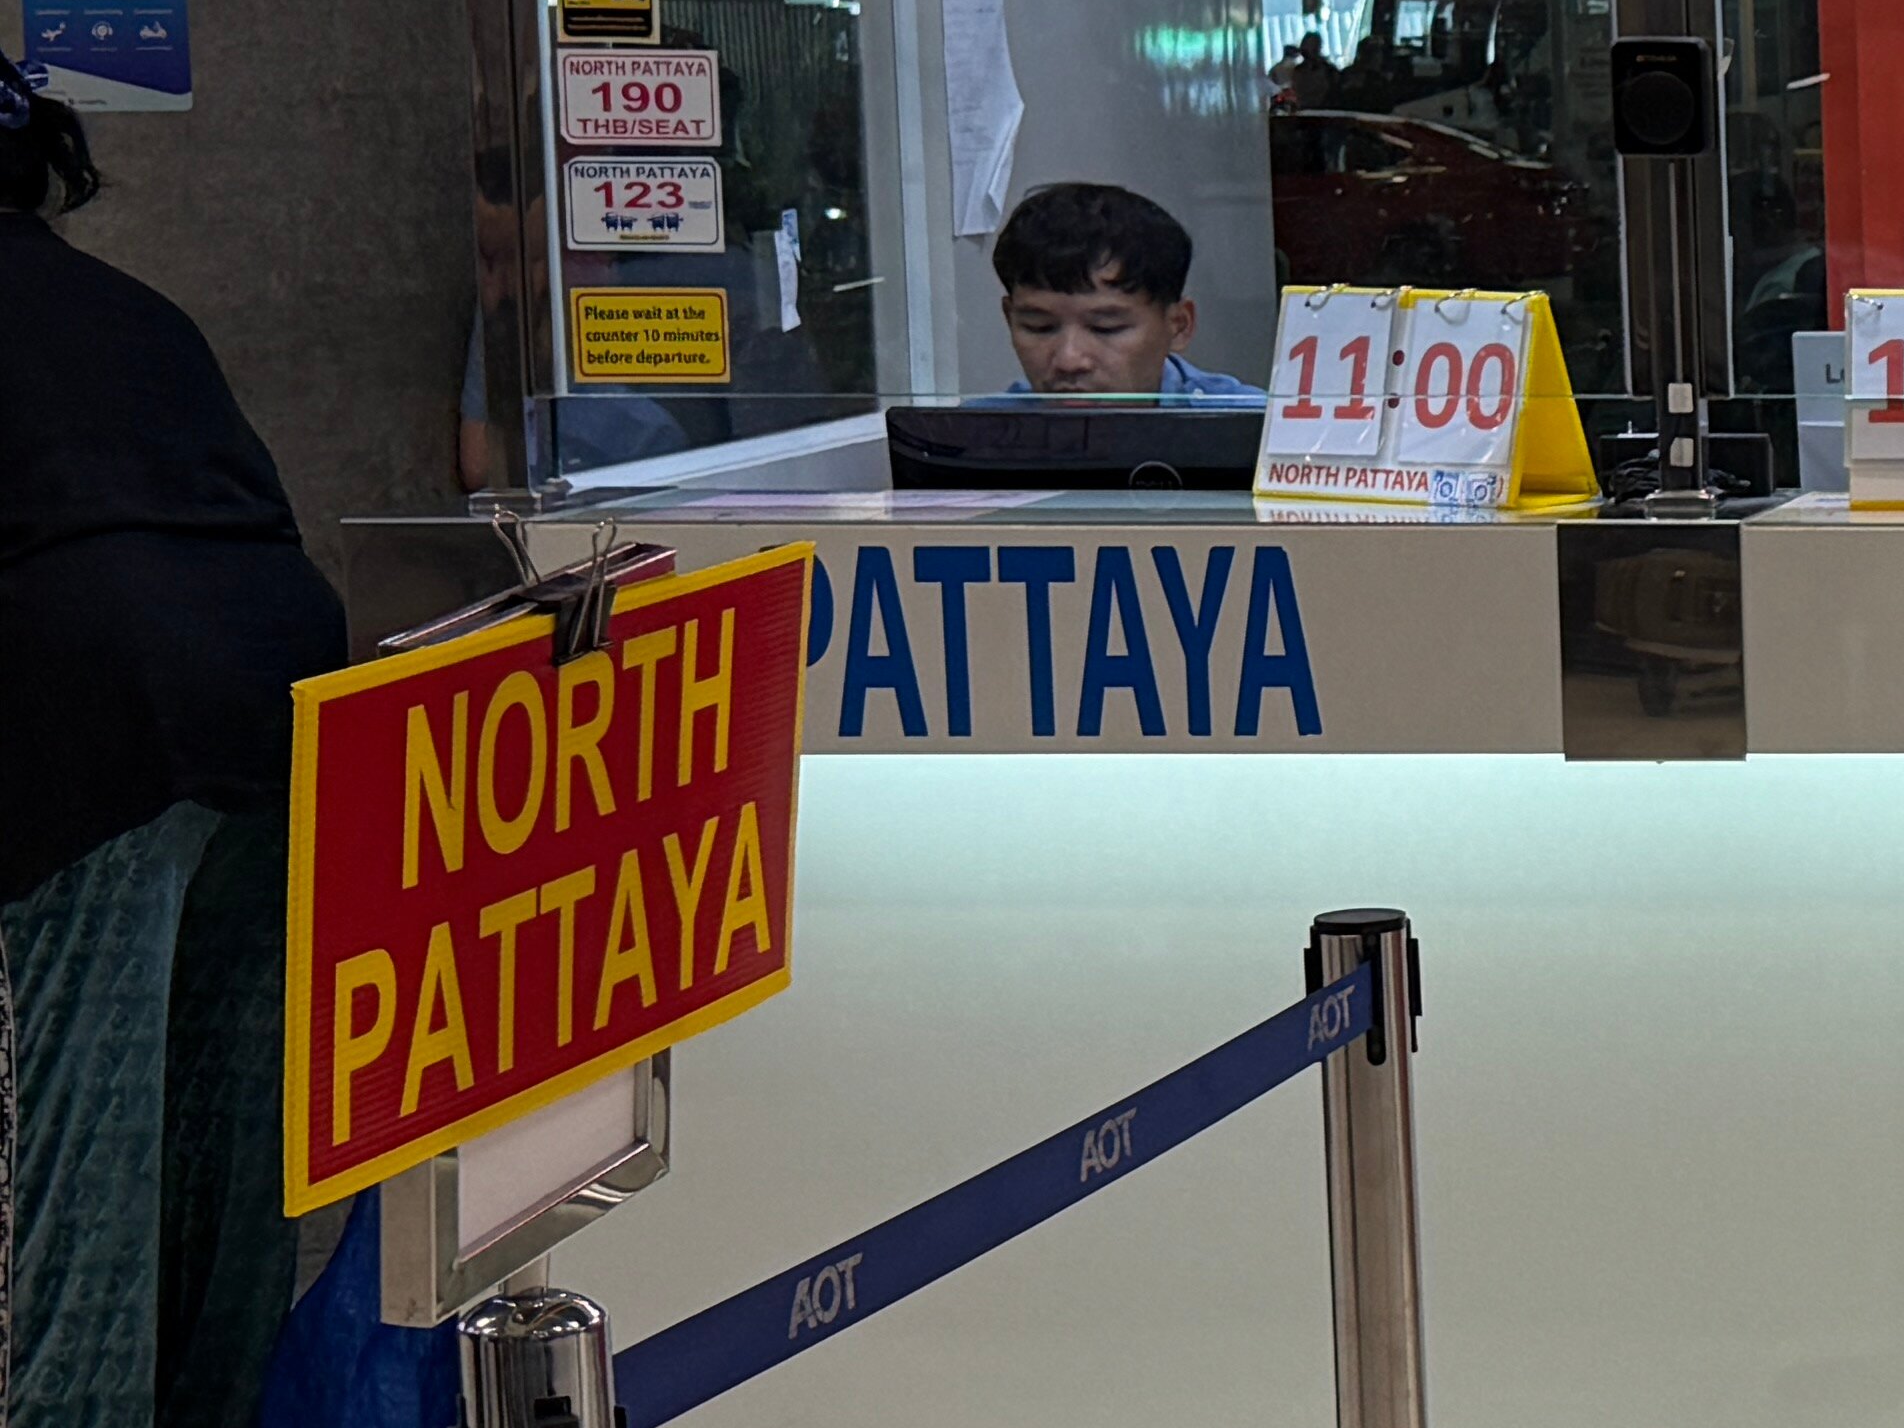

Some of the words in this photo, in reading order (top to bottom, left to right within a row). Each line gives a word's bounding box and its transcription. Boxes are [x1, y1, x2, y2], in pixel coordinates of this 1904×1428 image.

[569, 60, 625, 76] NORTH
[632, 60, 707, 77] PATTAYA
[591, 81, 682, 114] 190
[577, 118, 706, 136] THB/SEAT
[574, 165, 630, 179] NORTH
[636, 166, 712, 180] PATTAYA
[593, 181, 684, 209] 123
[584, 306, 629, 321] Please
[632, 306, 662, 321] wait
[666, 307, 680, 321] at
[683, 306, 705, 321] the
[586, 330, 639, 343] counter
[643, 329, 660, 343] 10
[663, 329, 720, 343] minutes
[587, 351, 633, 365] before
[636, 351, 710, 368] departure.
[1282, 335, 1516, 430] 11:00
[1268, 463, 1340, 487] NORTH
[1344, 467, 1429, 493] PATTAYA
[402, 607, 735, 890] NORTH
[332, 801, 770, 1146] PATTAYA
[1307, 984, 1355, 1052] AOT
[1080, 1107, 1137, 1182] AOT
[788, 1253, 862, 1339] AOT
